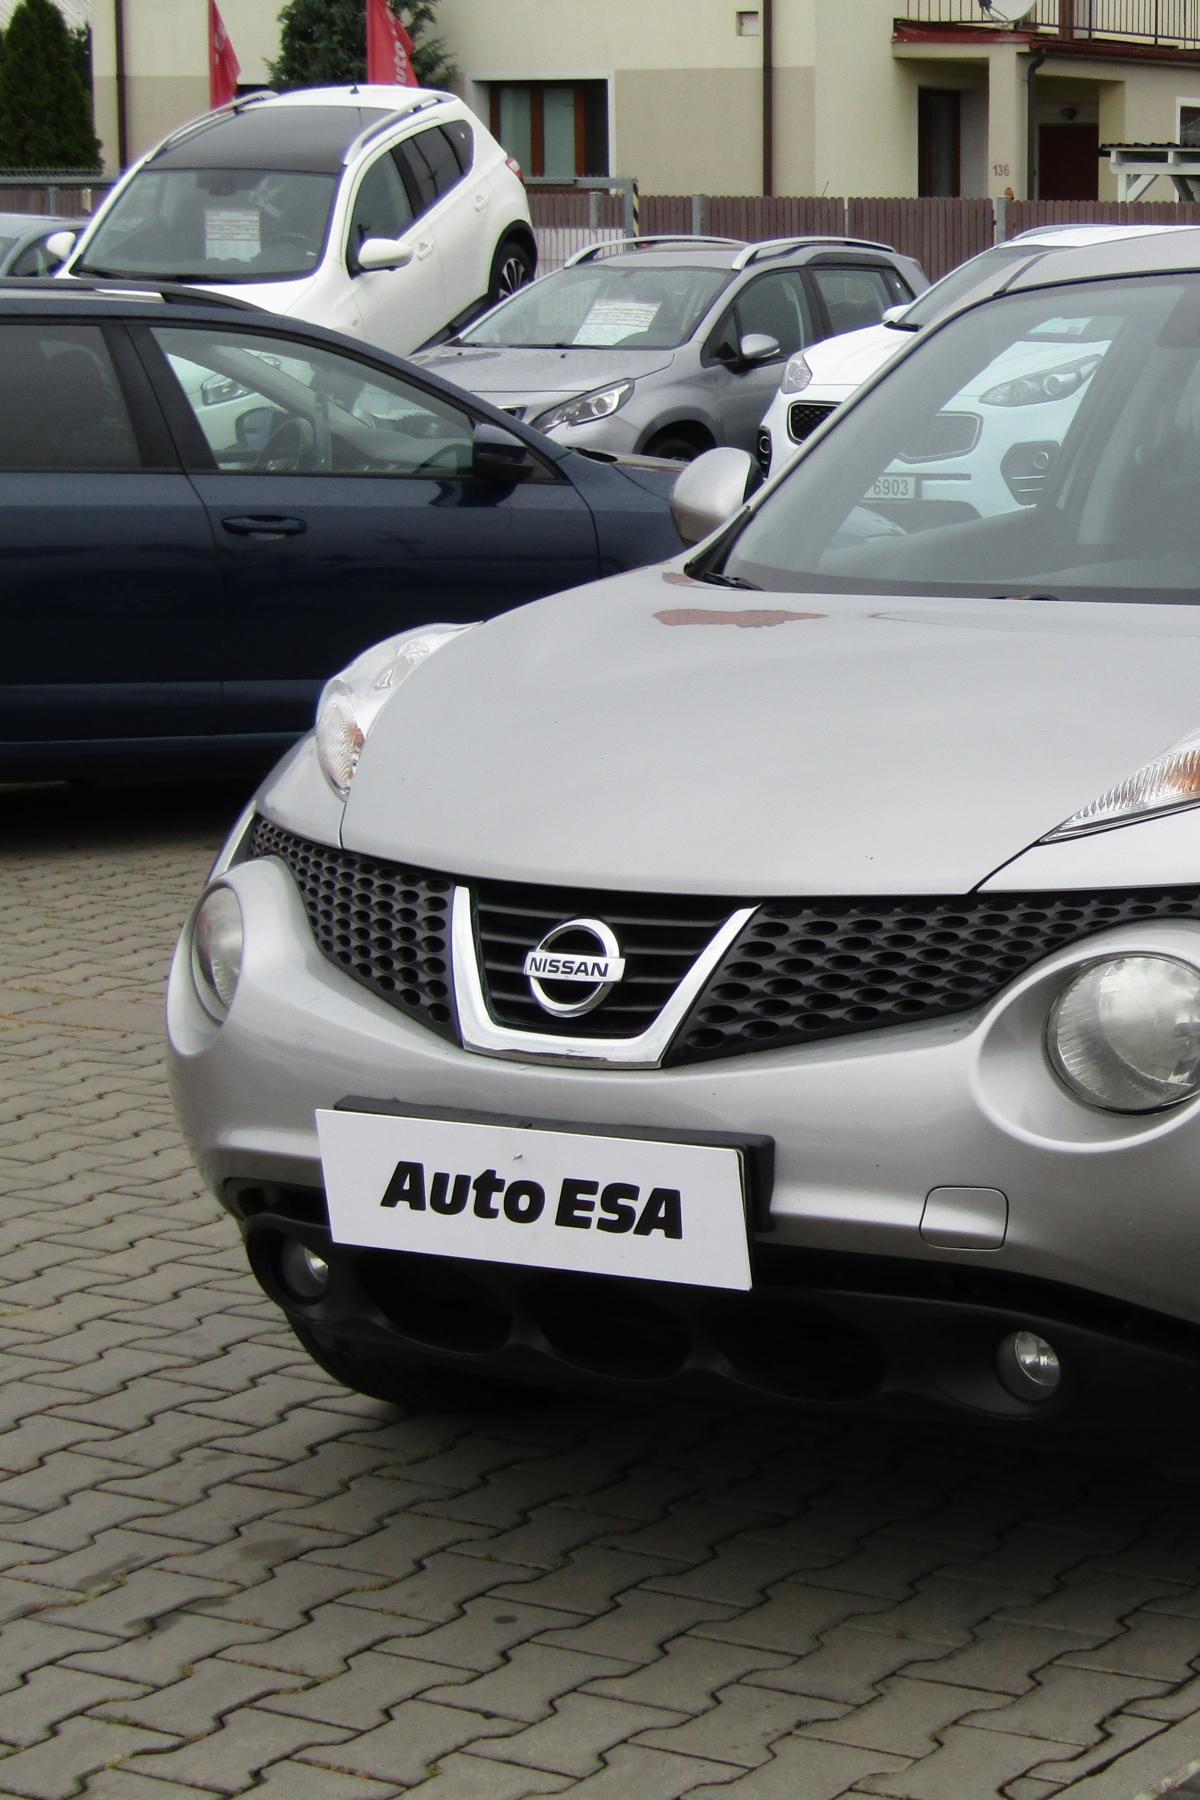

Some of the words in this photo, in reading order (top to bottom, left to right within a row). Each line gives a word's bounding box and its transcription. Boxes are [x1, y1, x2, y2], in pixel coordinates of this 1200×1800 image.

[394, 38, 408, 84] uto
[992, 163, 1010, 177] 136
[873, 479, 909, 496] 6903
[529, 956, 609, 978] NISSAN
[380, 1160, 545, 1224] Auto
[554, 1177, 683, 1239] ESA
